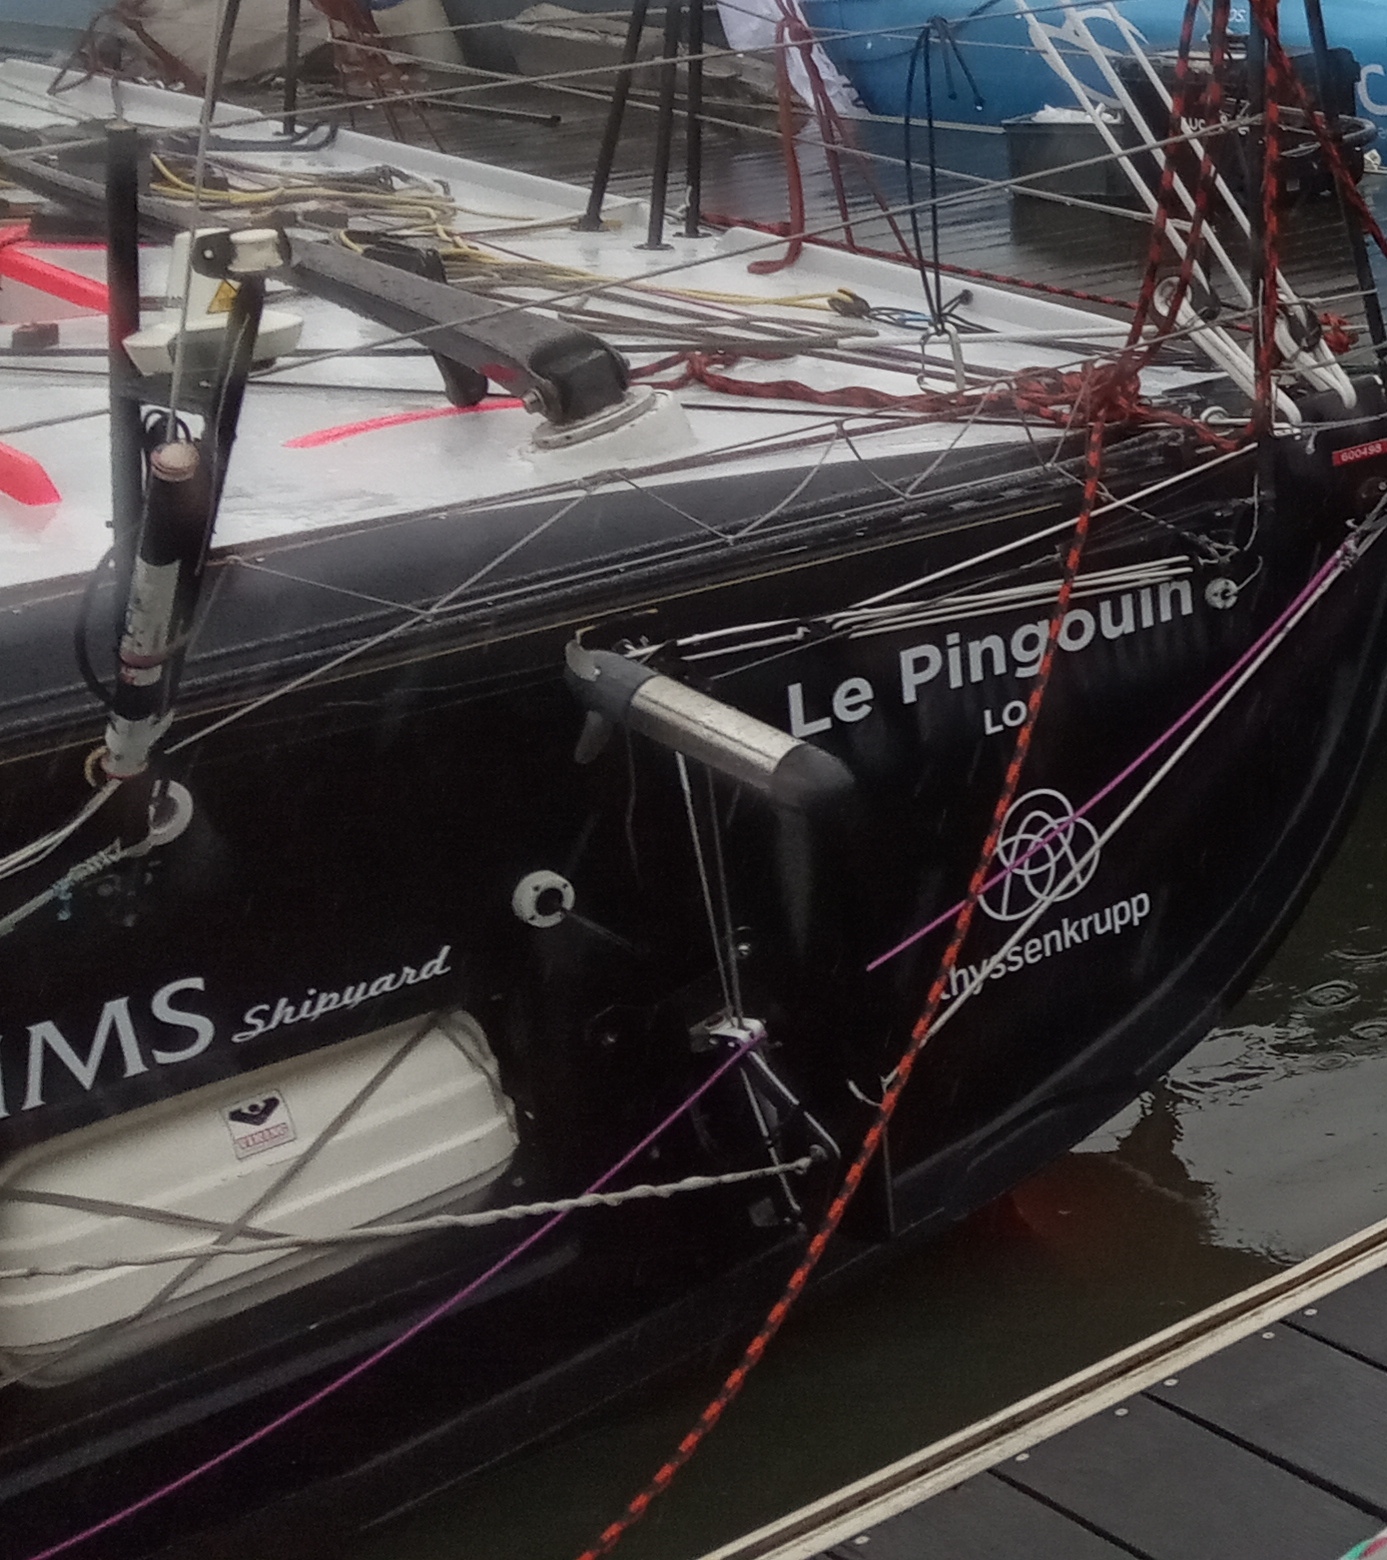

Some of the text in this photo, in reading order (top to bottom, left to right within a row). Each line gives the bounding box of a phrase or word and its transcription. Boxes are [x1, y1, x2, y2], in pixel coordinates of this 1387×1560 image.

[787, 579, 1194, 739] Le Pingouin
[231, 945, 451, 1043] Shipyard
